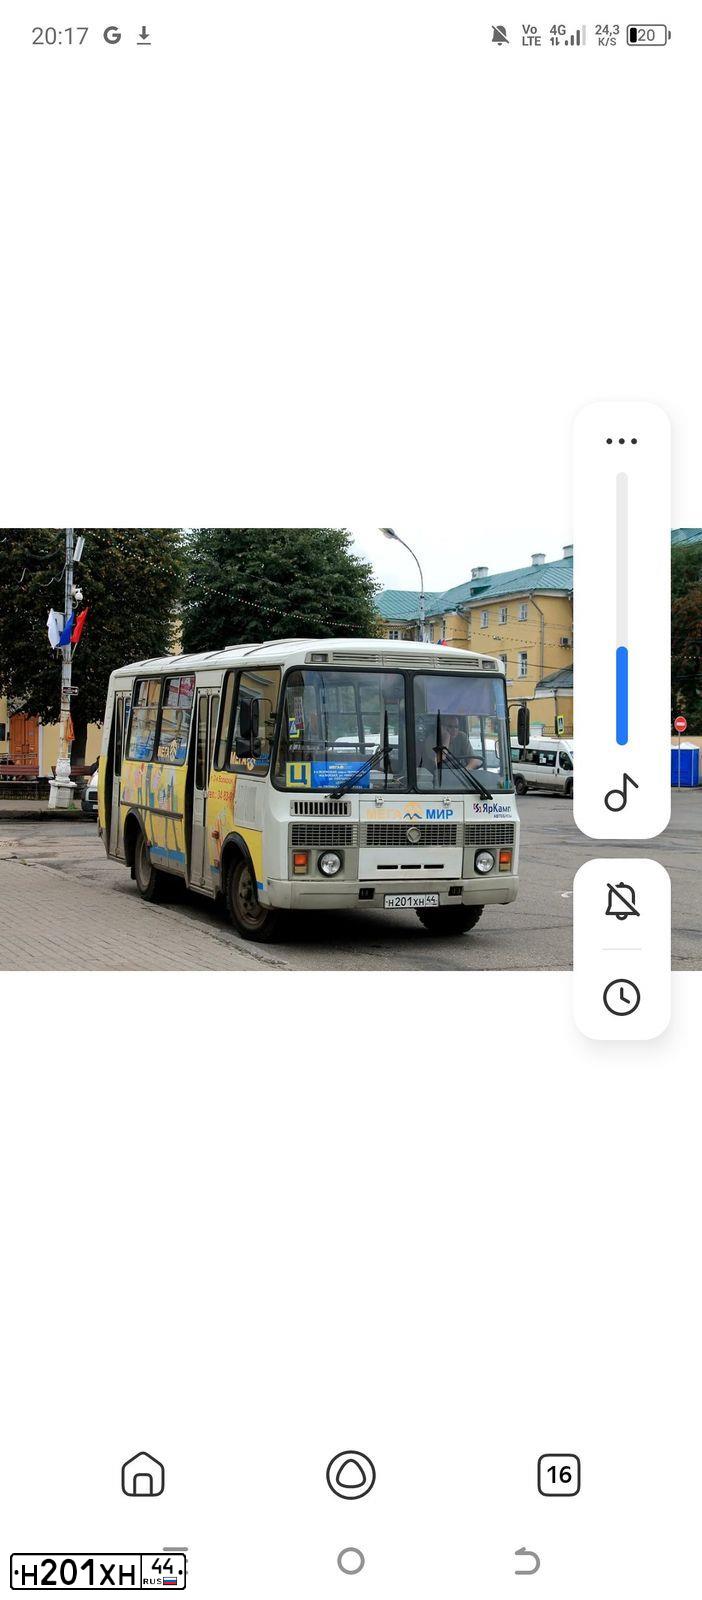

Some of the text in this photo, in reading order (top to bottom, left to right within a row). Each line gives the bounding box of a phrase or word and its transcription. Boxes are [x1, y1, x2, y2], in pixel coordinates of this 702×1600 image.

[31, 26, 89, 45] 20:17
[521, 24, 538, 35] Vo
[549, 24, 567, 36] 4G
[594, 24, 620, 36] 24,3
[637, 28, 656, 42] 20
[521, 36, 542, 47] LTE
[597, 37, 617, 47] K/S
[289, 764, 308, 785] Ц
[425, 808, 454, 820] МИР
[547, 1465, 572, 1484] 16
